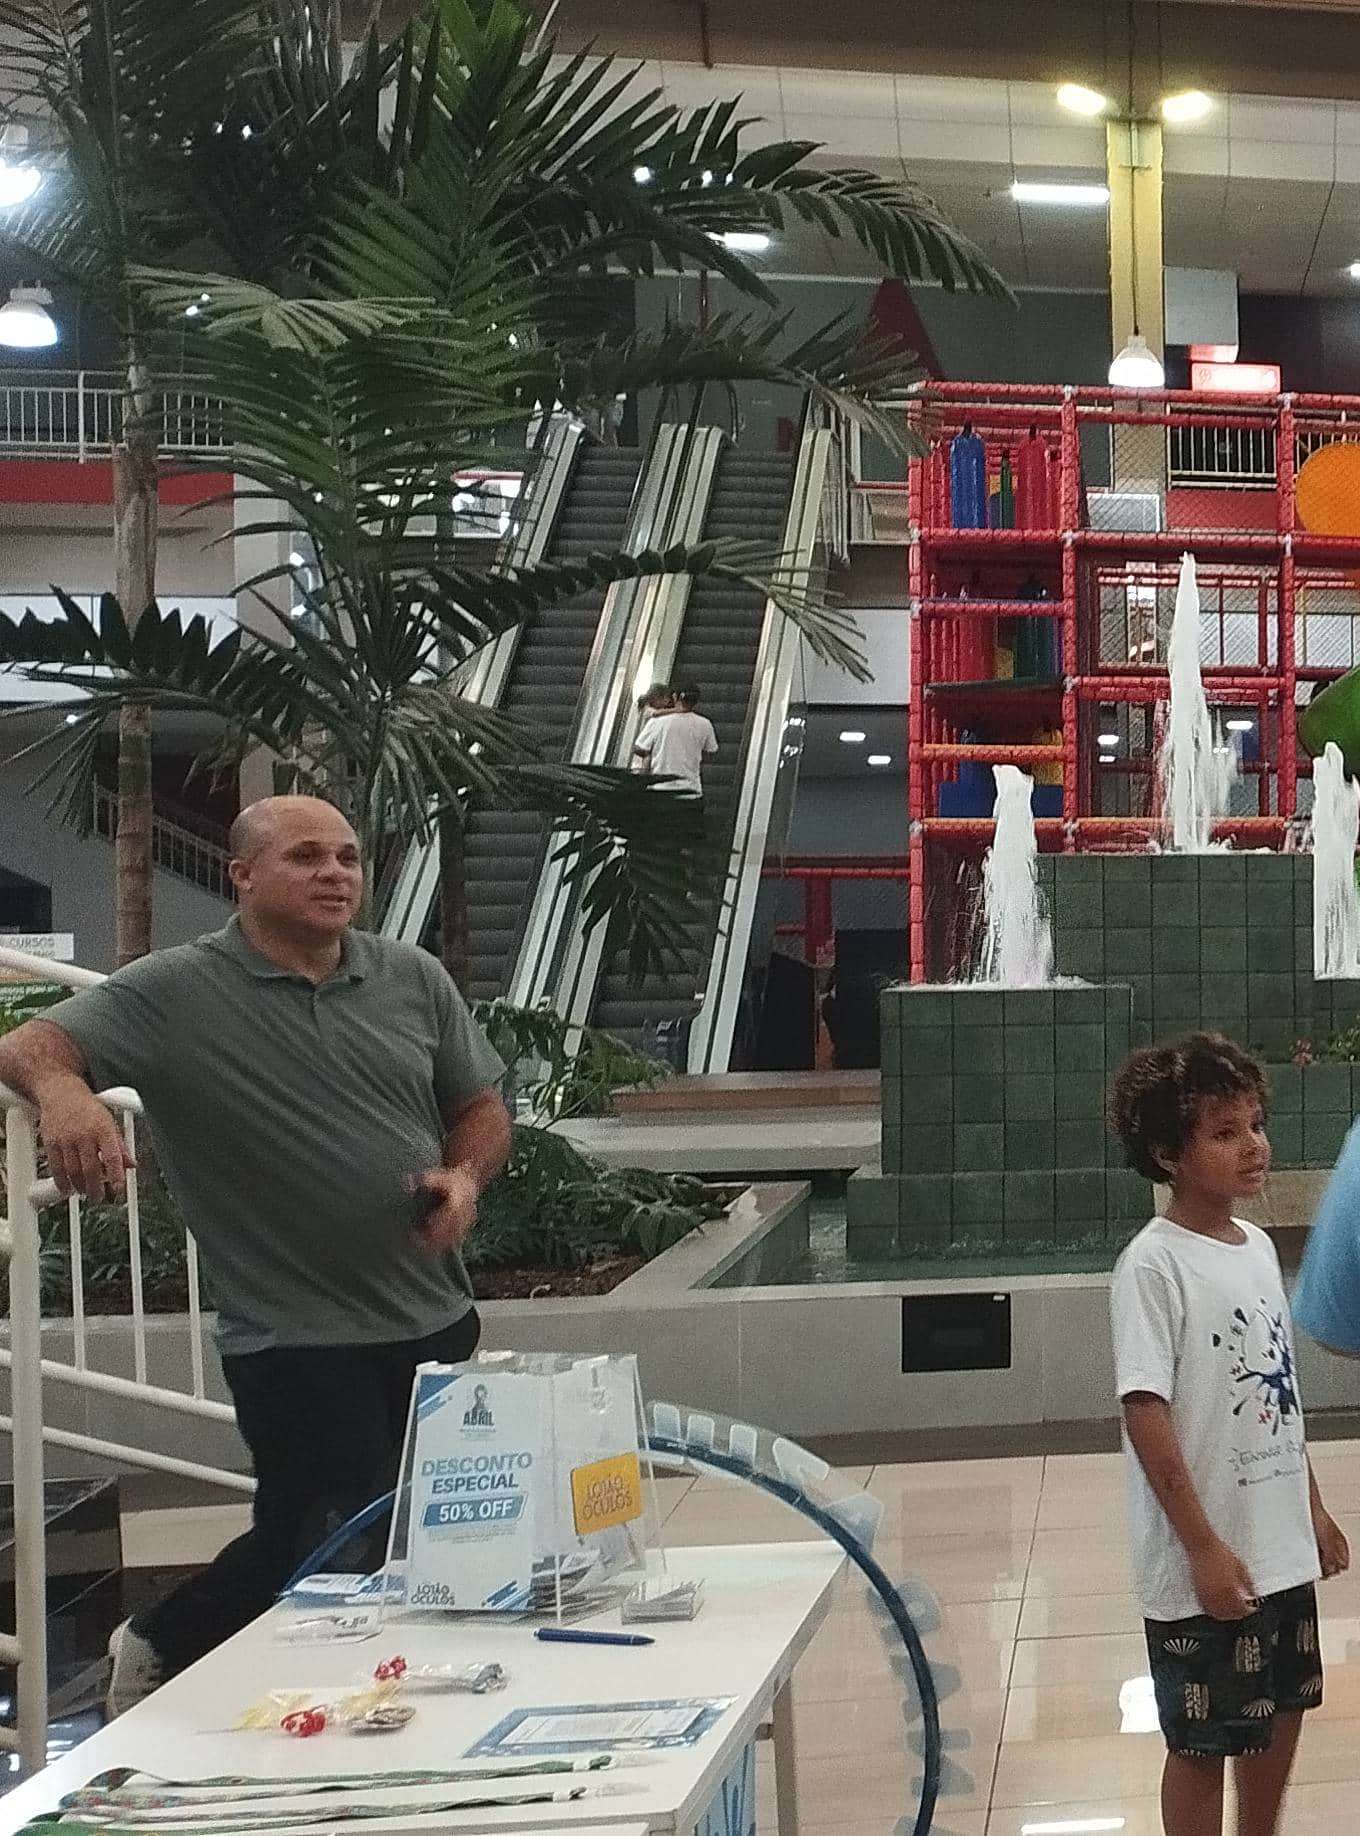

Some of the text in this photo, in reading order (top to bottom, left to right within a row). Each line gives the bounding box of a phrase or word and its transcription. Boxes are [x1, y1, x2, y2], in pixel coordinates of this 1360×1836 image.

[421, 1451, 533, 1476] DESCONTO
[432, 1473, 519, 1494] ESPECIAL
[440, 1499, 513, 1522] 50% OFF
